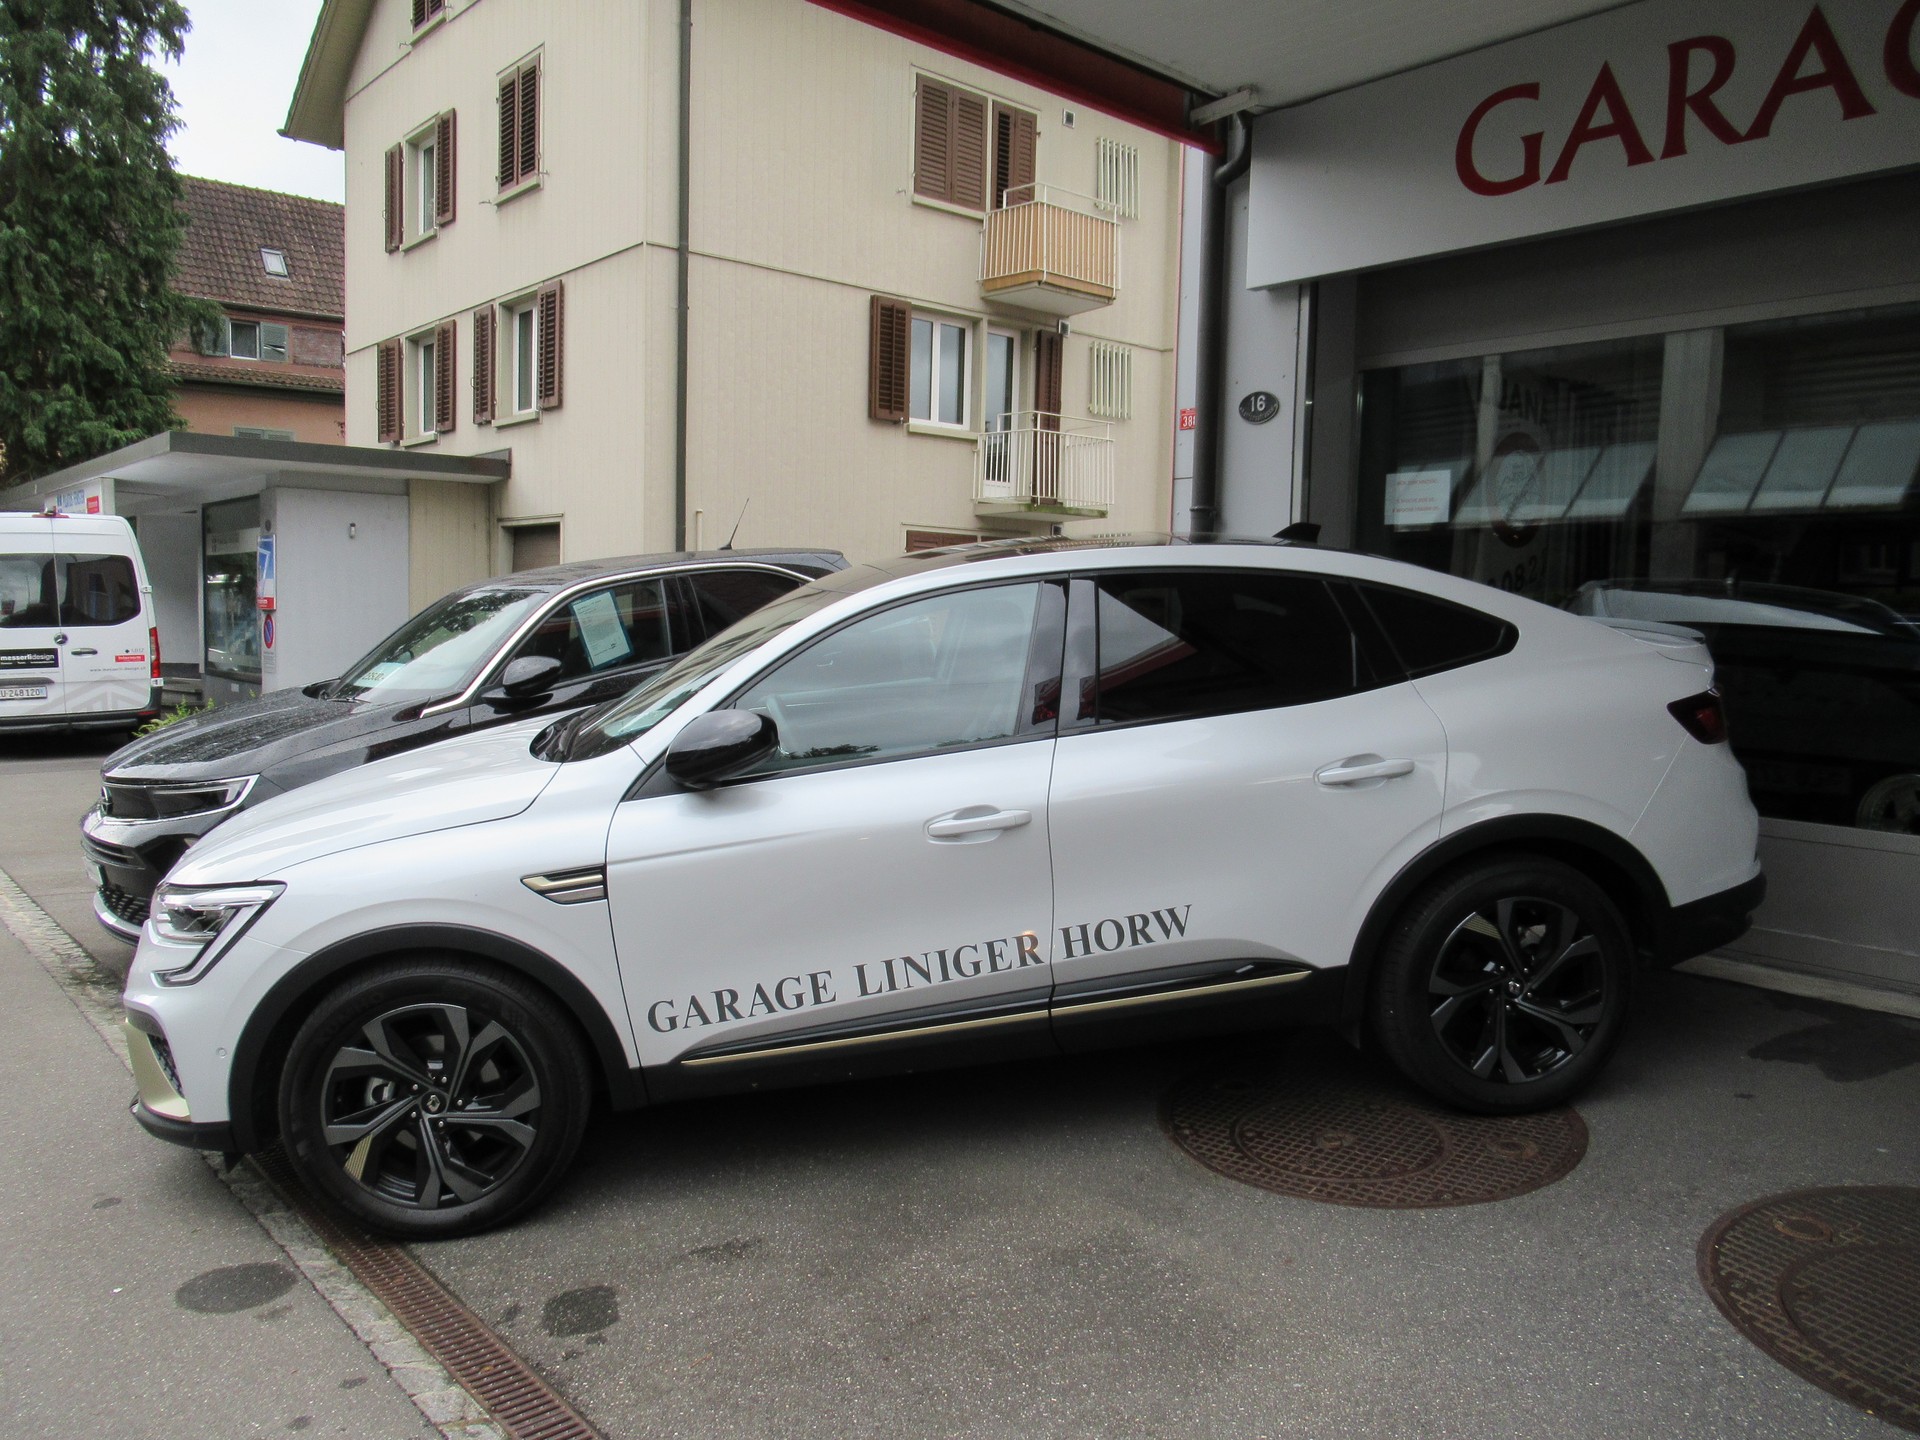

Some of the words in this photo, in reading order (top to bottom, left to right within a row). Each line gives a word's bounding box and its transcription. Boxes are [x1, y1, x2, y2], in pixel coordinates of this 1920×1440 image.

[1250, 394, 1266, 412] 16
[646, 969, 838, 1034] GARAGE
[852, 932, 1045, 999] LINIGER
[1057, 903, 1194, 961] HORW
